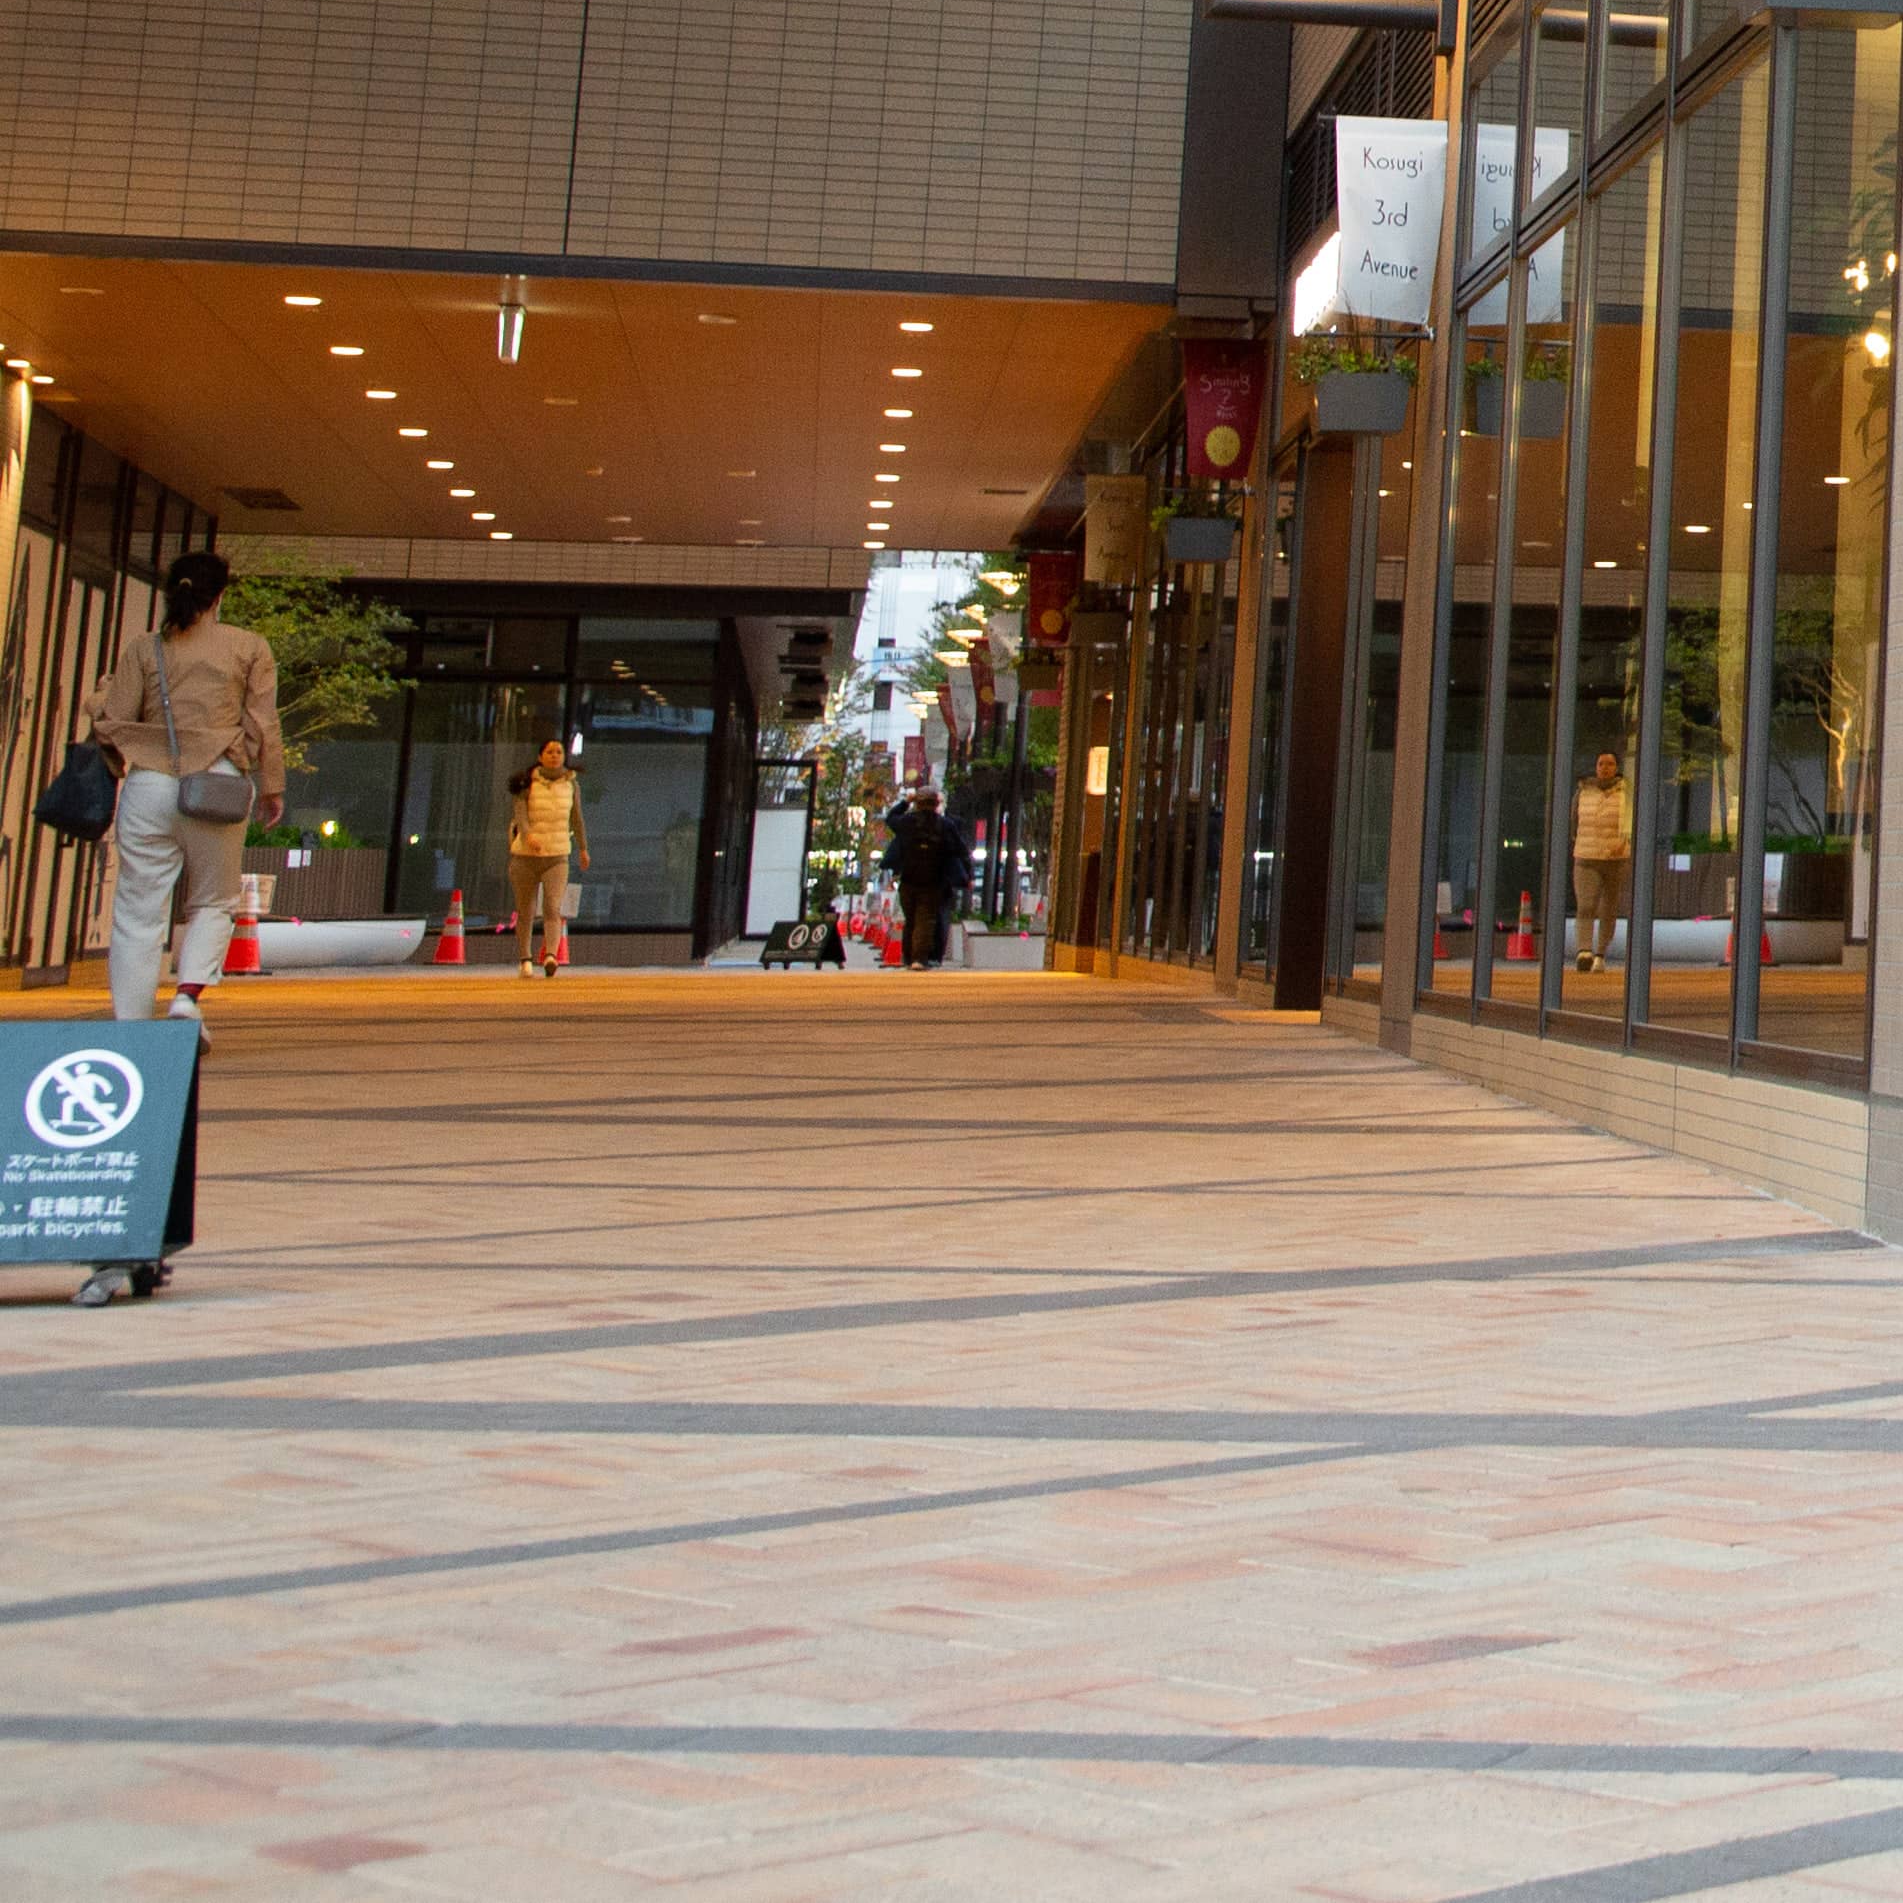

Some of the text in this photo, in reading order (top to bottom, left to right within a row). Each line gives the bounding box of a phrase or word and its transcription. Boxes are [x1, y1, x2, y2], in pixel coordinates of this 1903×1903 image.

[1363, 146, 1423, 179] Kosugi
[1372, 199, 1408, 227] 3rd
[1360, 249, 1419, 280] Avenue
[6, 1151, 141, 1169] スケートボード禁止
[44, 1218, 129, 1239] bicycles.
